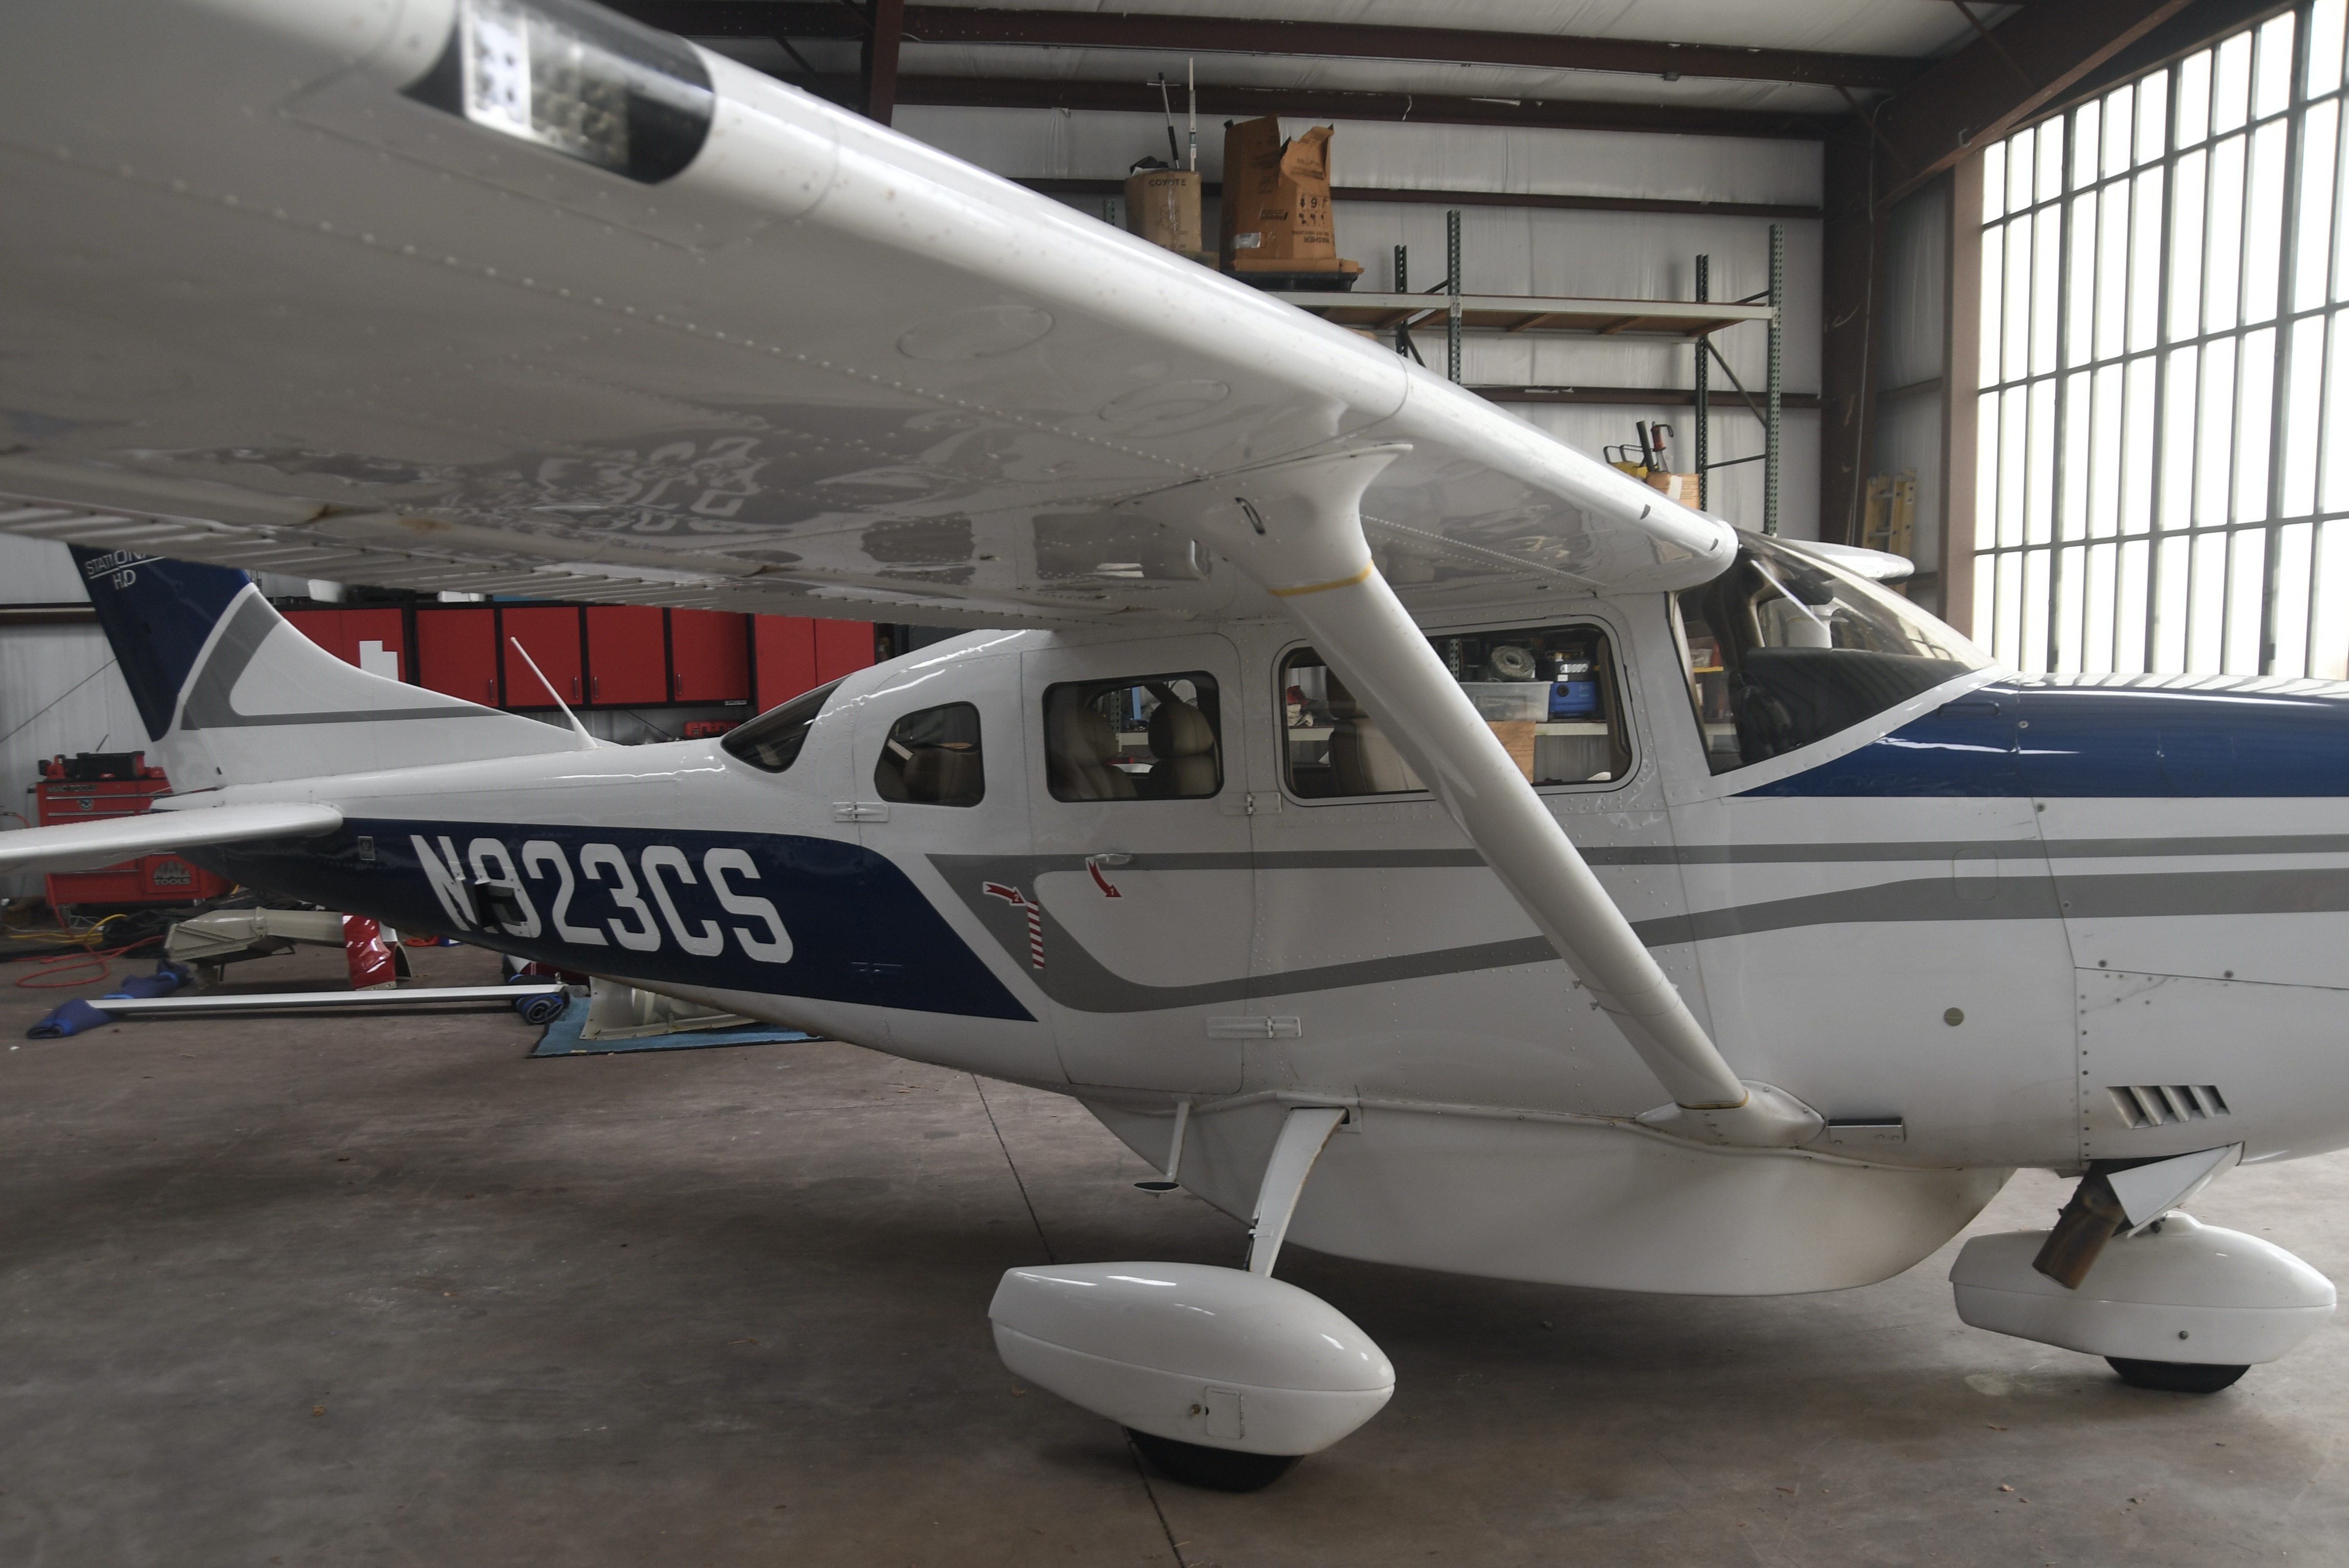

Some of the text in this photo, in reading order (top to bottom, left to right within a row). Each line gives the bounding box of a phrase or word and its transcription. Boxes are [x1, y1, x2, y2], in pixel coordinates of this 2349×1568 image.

[85, 550, 147, 575] STATION
[112, 569, 136, 589] HD
[153, 860, 191, 878] MAC
[153, 878, 191, 886] TOOLS
[410, 835, 794, 963] N923CS
